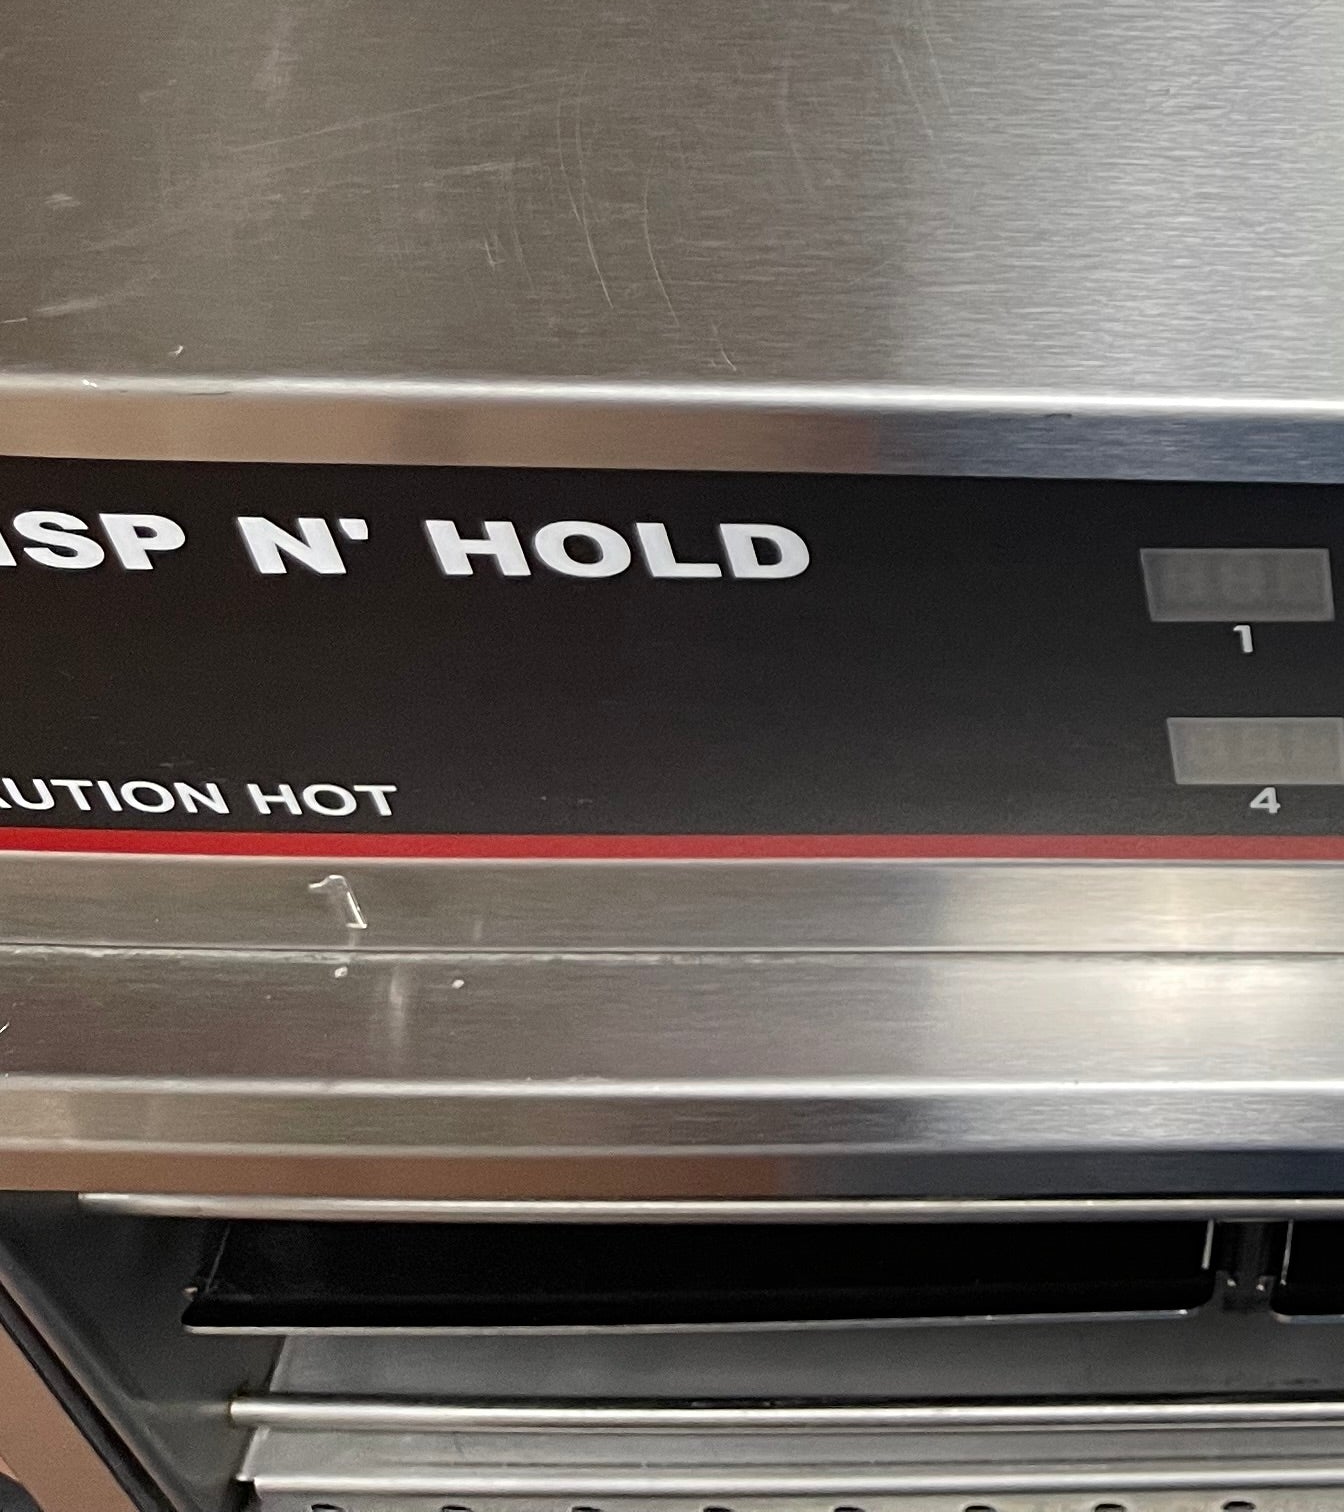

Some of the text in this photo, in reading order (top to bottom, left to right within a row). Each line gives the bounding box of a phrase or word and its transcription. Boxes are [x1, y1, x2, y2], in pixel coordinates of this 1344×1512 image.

[0, 510, 811, 578] SP N' HOLD
[1232, 625, 1254, 653] 1
[0, 777, 398, 817] UTION HOT
[1249, 787, 1281, 814] 4
